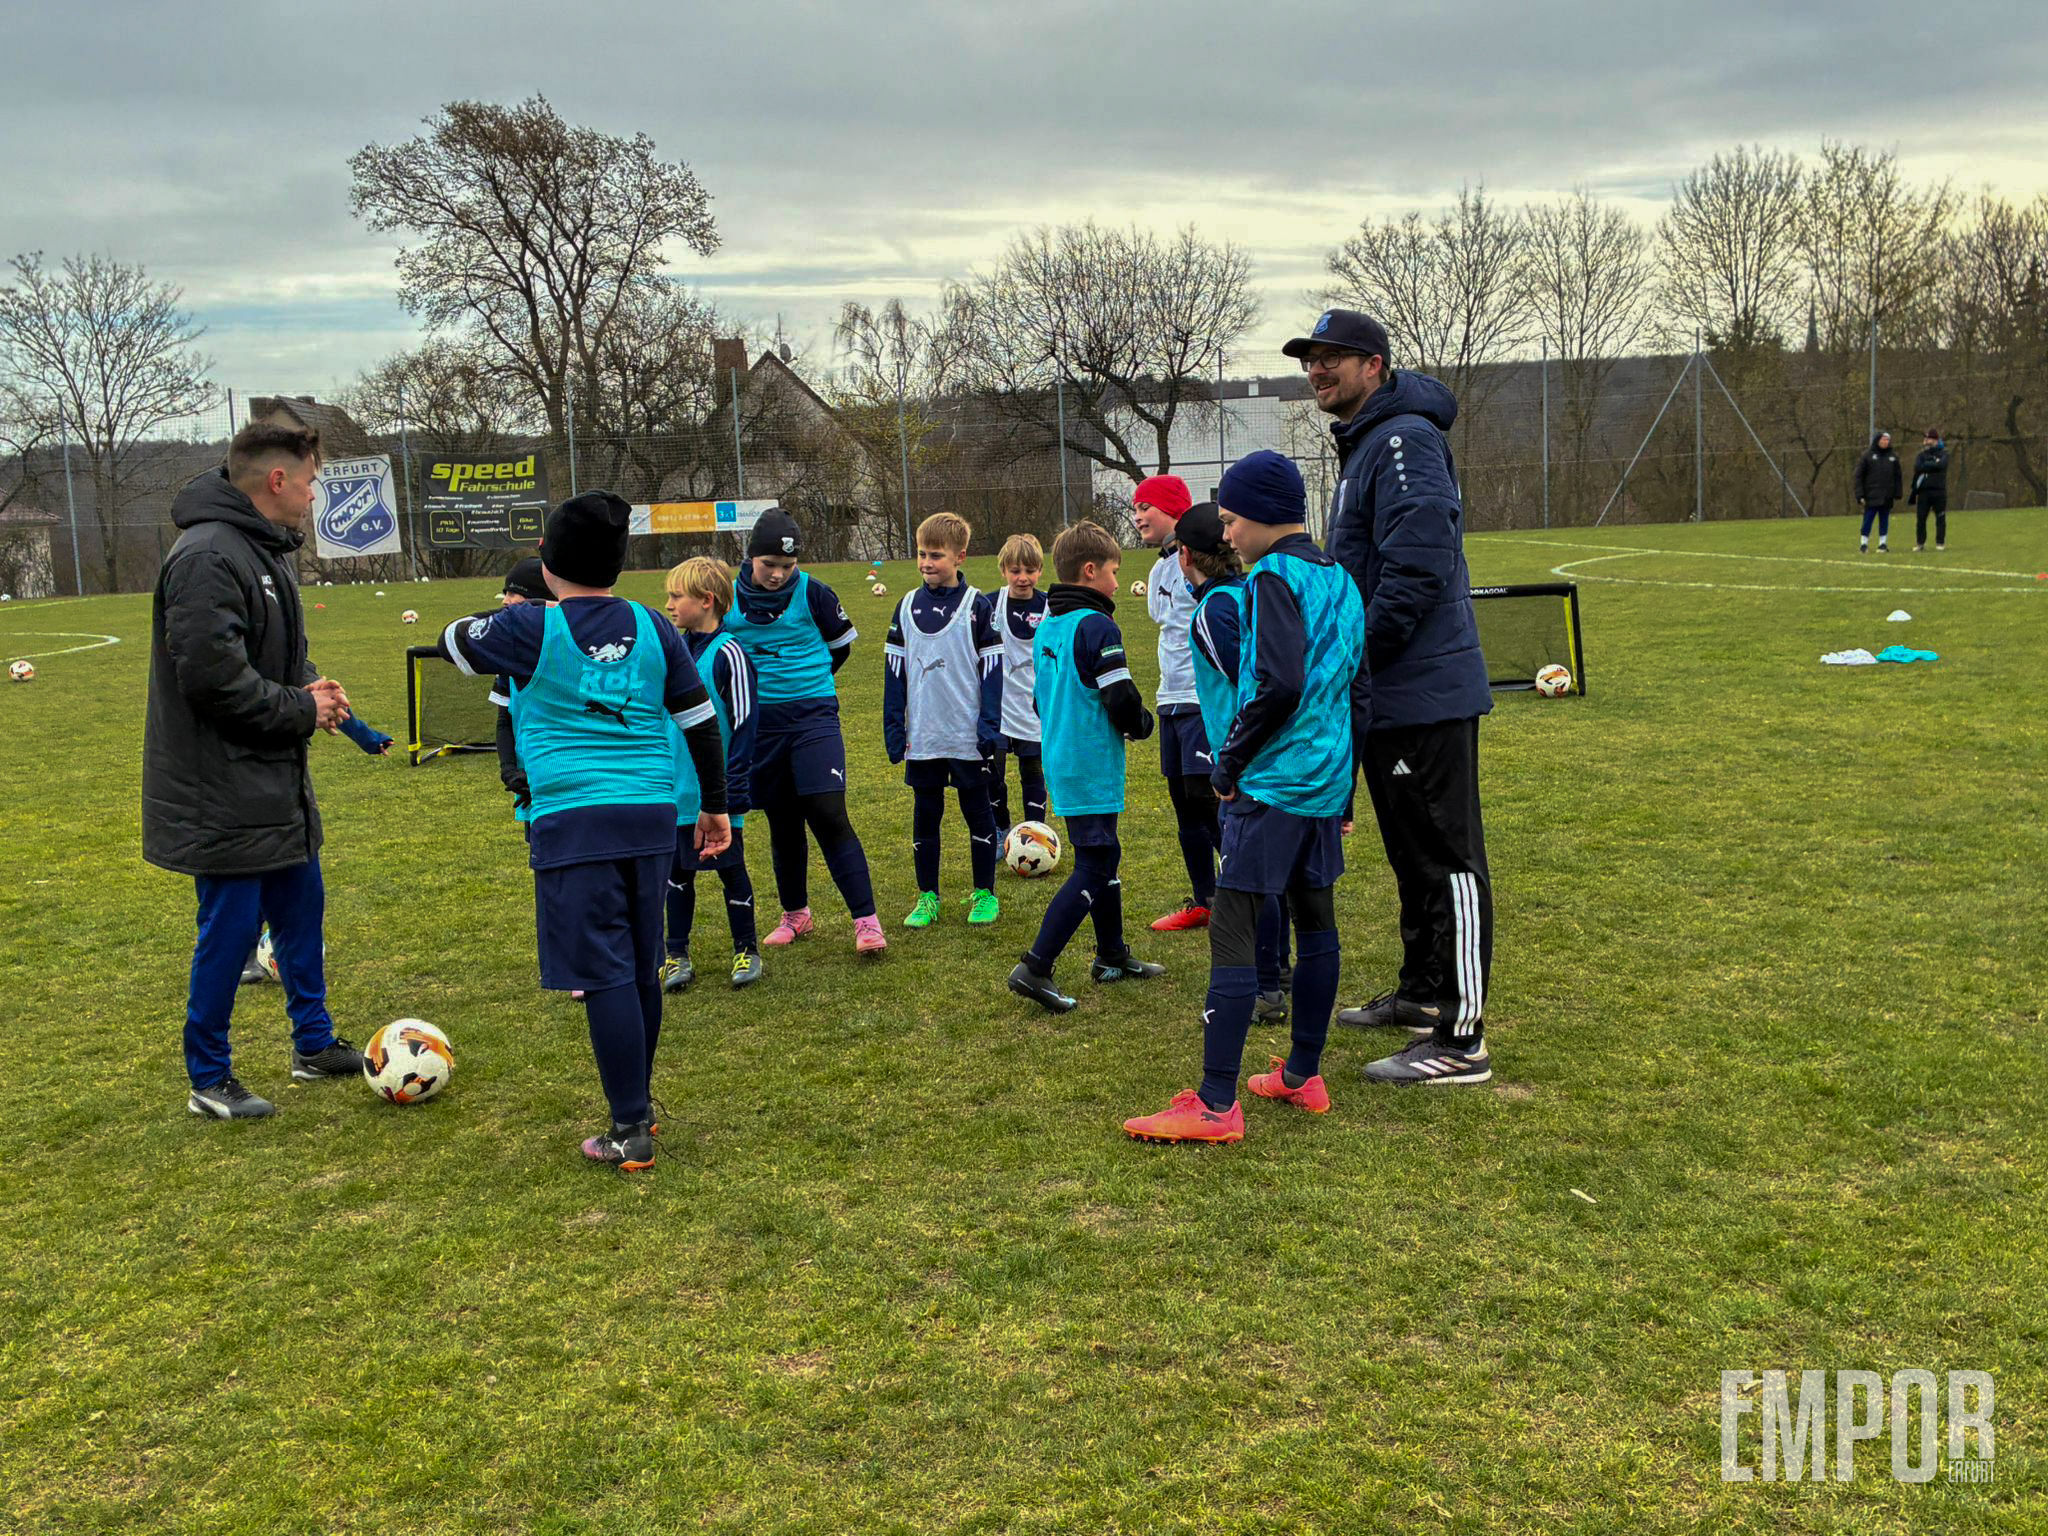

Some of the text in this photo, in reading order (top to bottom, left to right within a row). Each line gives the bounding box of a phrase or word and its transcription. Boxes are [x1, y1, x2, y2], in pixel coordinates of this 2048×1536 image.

[323, 463, 378, 476] ERFURT
[430, 455, 535, 492] speed
[459, 480, 536, 493] Fahrschule
[361, 520, 384, 532] e.V.
